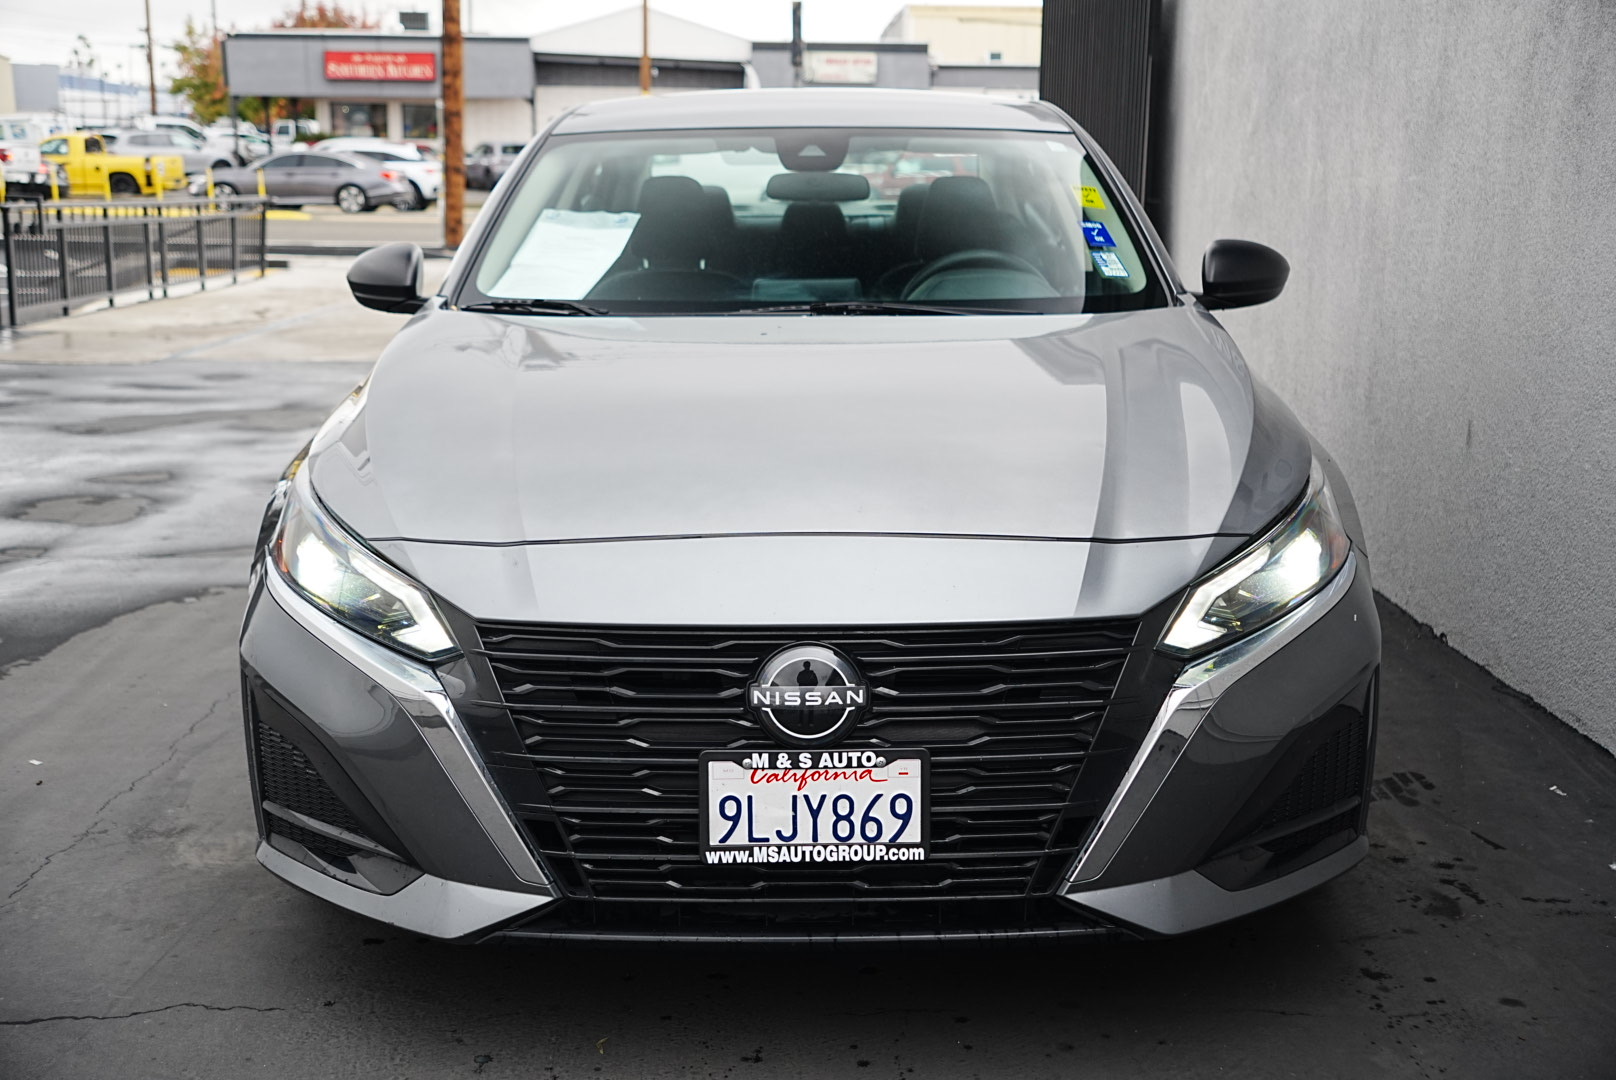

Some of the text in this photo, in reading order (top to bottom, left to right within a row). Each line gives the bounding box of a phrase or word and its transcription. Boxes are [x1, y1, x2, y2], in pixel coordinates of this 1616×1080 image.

[753, 689, 864, 706] NISSAN
[751, 751, 877, 769] M & S AUTO
[750, 768, 888, 792] California
[718, 792, 914, 844] 9LJY869
[705, 844, 925, 865] www.MSAUTOGROUP.com
